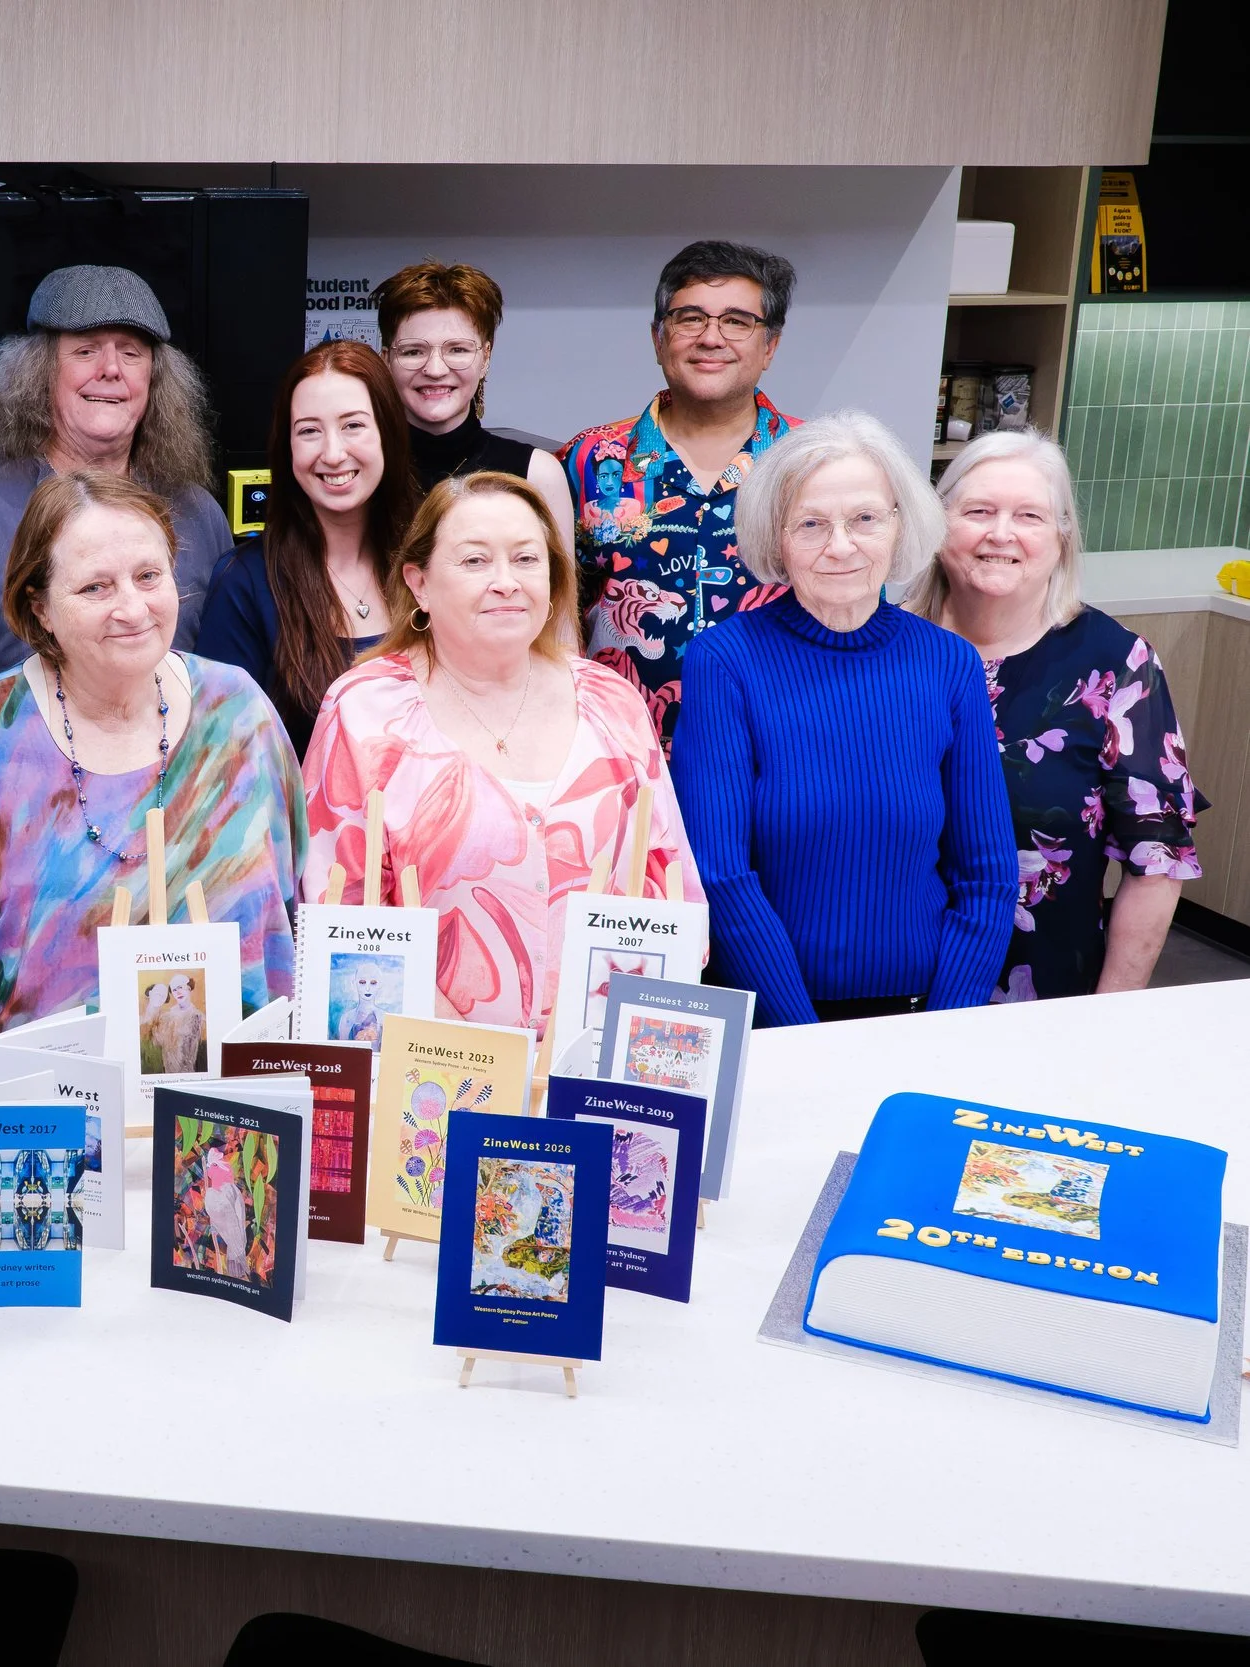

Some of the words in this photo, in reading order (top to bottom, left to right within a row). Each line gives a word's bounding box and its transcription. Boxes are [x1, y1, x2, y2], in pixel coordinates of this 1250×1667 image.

[306, 278, 369, 292] tudent
[306, 296, 339, 310] ood
[587, 913, 678, 935] ZineWest
[327, 926, 412, 942] ZineWest
[618, 936, 643, 947] 2007
[135, 953, 190, 964] ZineWest
[194, 952, 206, 962] 10
[638, 992, 682, 1006] ZineWest
[688, 1001, 710, 1011] 2022
[408, 1042, 464, 1059] ZineWest
[469, 1053, 494, 1064] 2023
[252, 1059, 313, 1073] ZineWest
[315, 1063, 342, 1073] 2018
[58, 1084, 99, 1101] West
[584, 1095, 645, 1114] ZineWest
[647, 1108, 674, 1121] 2019
[194, 1108, 235, 1123] ZineWest
[239, 1117, 260, 1128] 2021
[30, 1125, 57, 1134] 2017
[483, 1138, 540, 1151] ZineWest
[544, 1143, 571, 1154] 2026
[619, 1250, 646, 1262] Sydney
[626, 1264, 648, 1272] prose
[187, 1273, 210, 1281] western
[212, 1278, 231, 1287] sydney
[232, 1282, 251, 1294] writing
